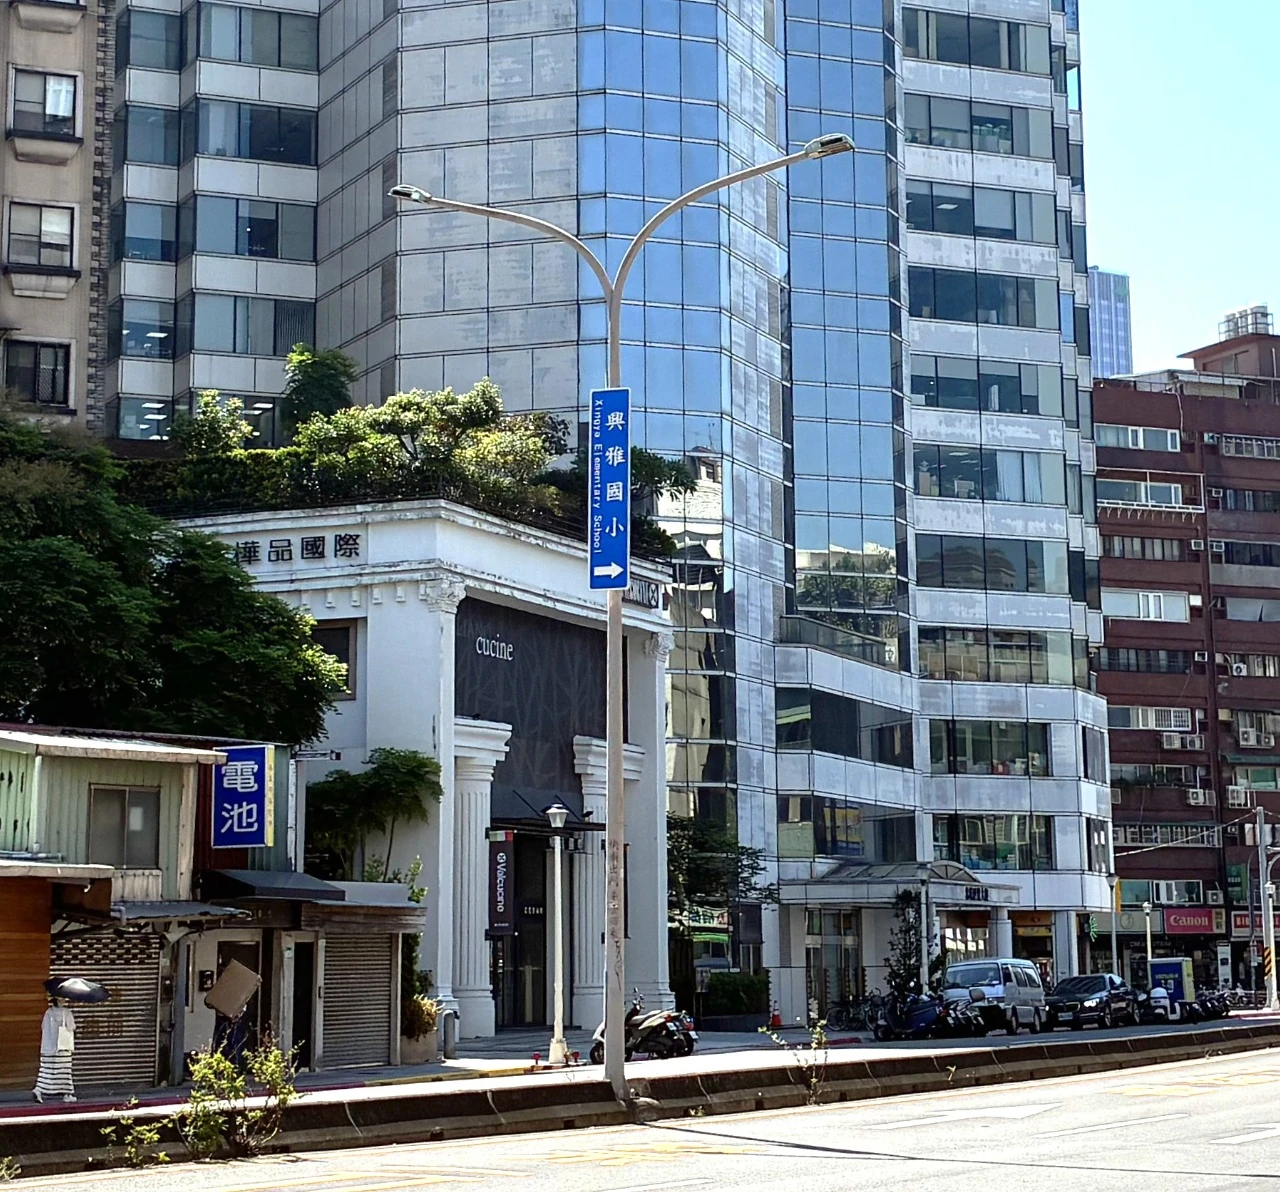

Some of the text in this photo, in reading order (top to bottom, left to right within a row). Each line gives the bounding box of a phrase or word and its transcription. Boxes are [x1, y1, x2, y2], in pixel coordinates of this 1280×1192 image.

[593, 399, 604, 554] Xingya Elementary School
[605, 411, 626, 537] 興雅國小
[476, 633, 514, 661] cucine
[221, 761, 258, 833] 電池
[1170, 914, 1208, 926] Canon
